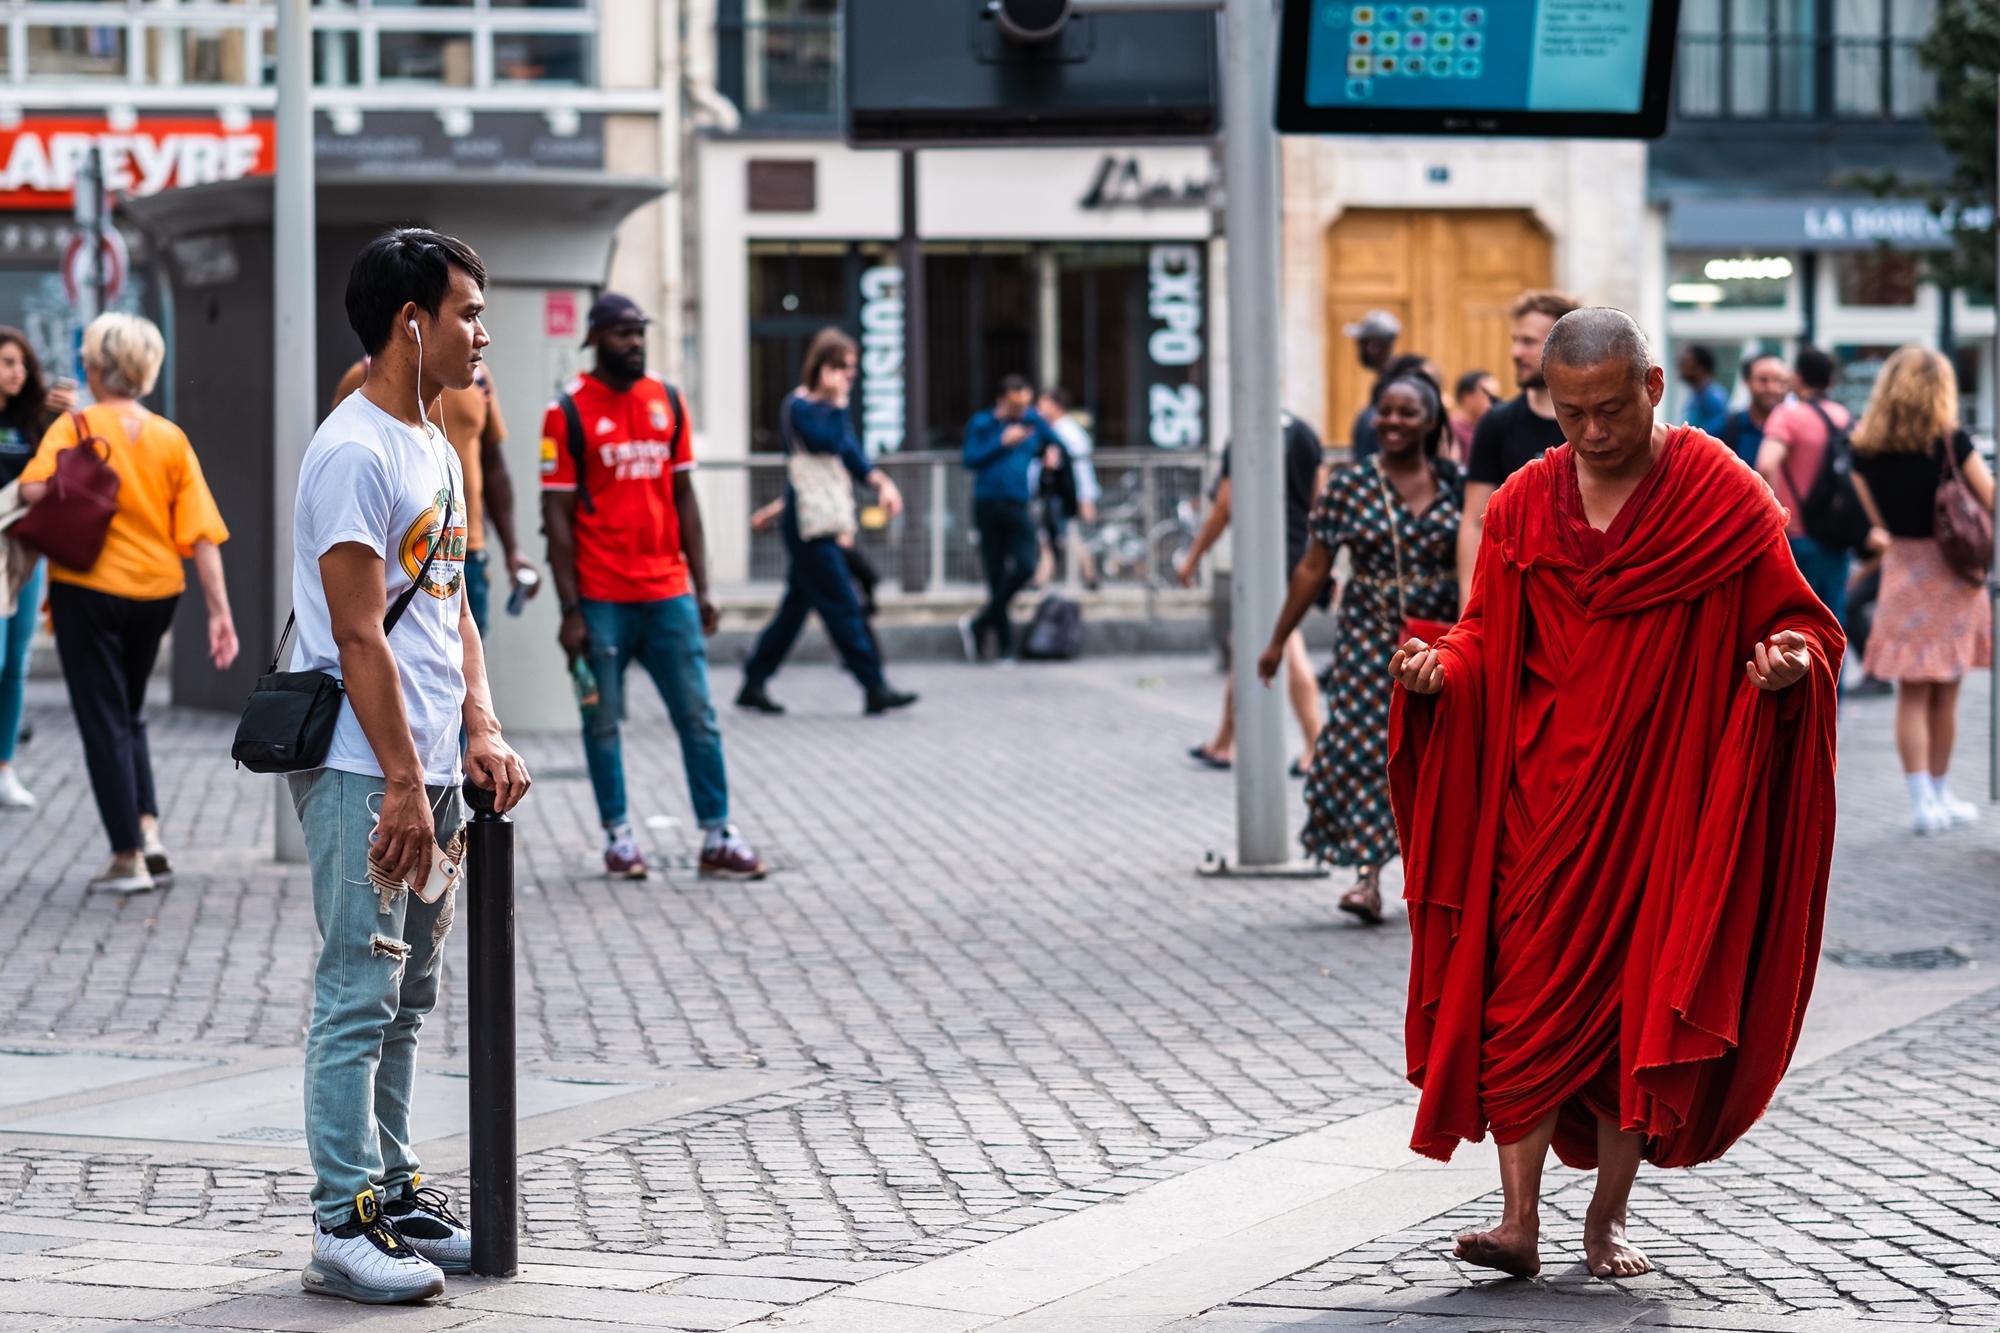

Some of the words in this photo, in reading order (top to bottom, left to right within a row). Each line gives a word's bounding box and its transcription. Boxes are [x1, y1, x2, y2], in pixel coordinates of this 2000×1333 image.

[0, 132, 263, 196] APEYRE
[1150, 246, 1202, 365] EXPO
[861, 266, 905, 460] CUISINE
[1150, 383, 1202, 447] 25
